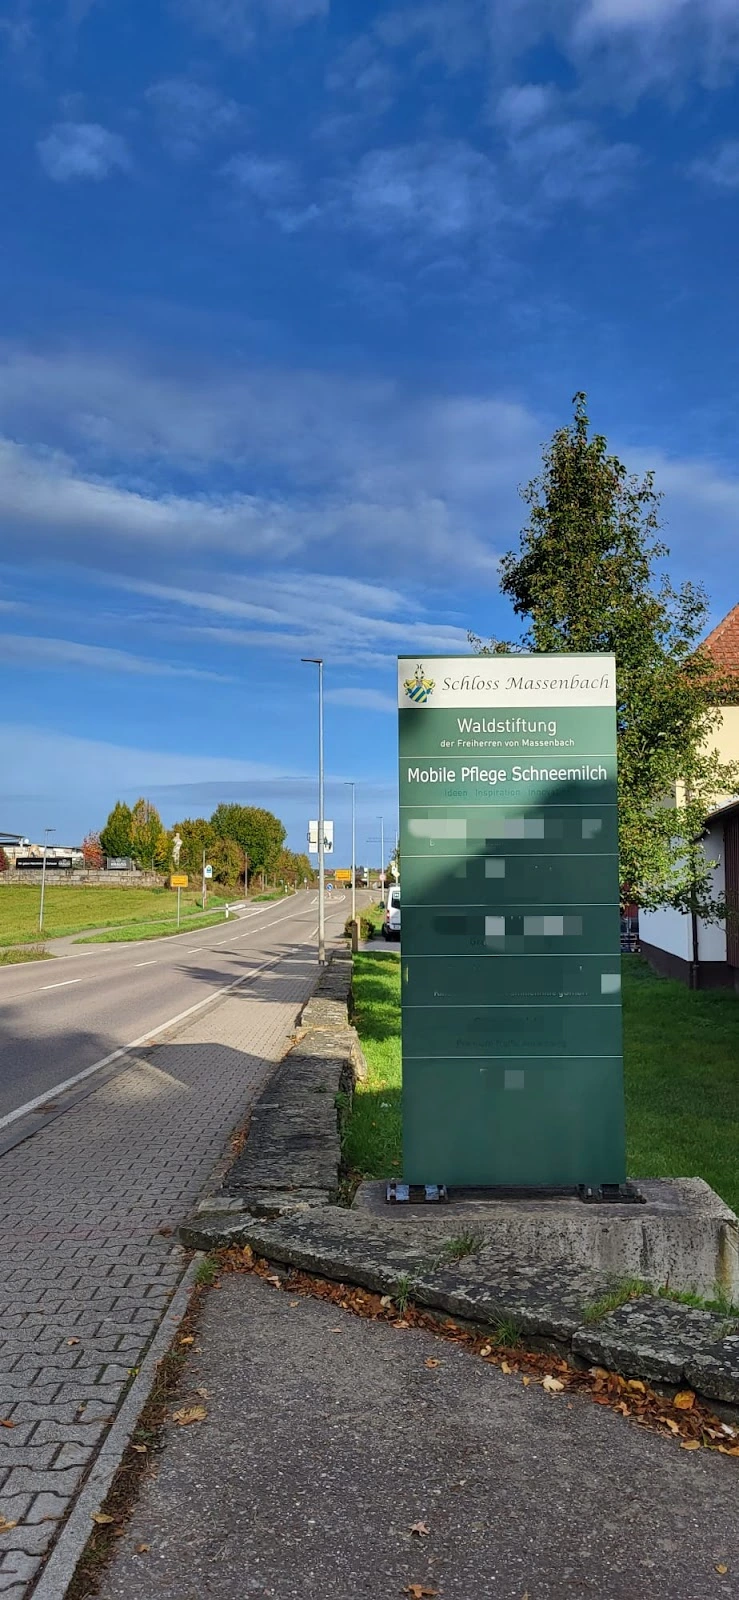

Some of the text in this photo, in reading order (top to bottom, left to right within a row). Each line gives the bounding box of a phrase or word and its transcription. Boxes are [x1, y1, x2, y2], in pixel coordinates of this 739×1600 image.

[442, 674, 609, 691] Schloss Massenbach
[457, 718, 557, 735] Waldstiftung
[440, 740, 454, 748] der
[457, 739, 502, 748] Freiherren
[522, 738, 575, 747] Massenbach
[408, 766, 607, 785] Mobile Pflege Schneemilch
[475, 789, 520, 799] Inspiration
